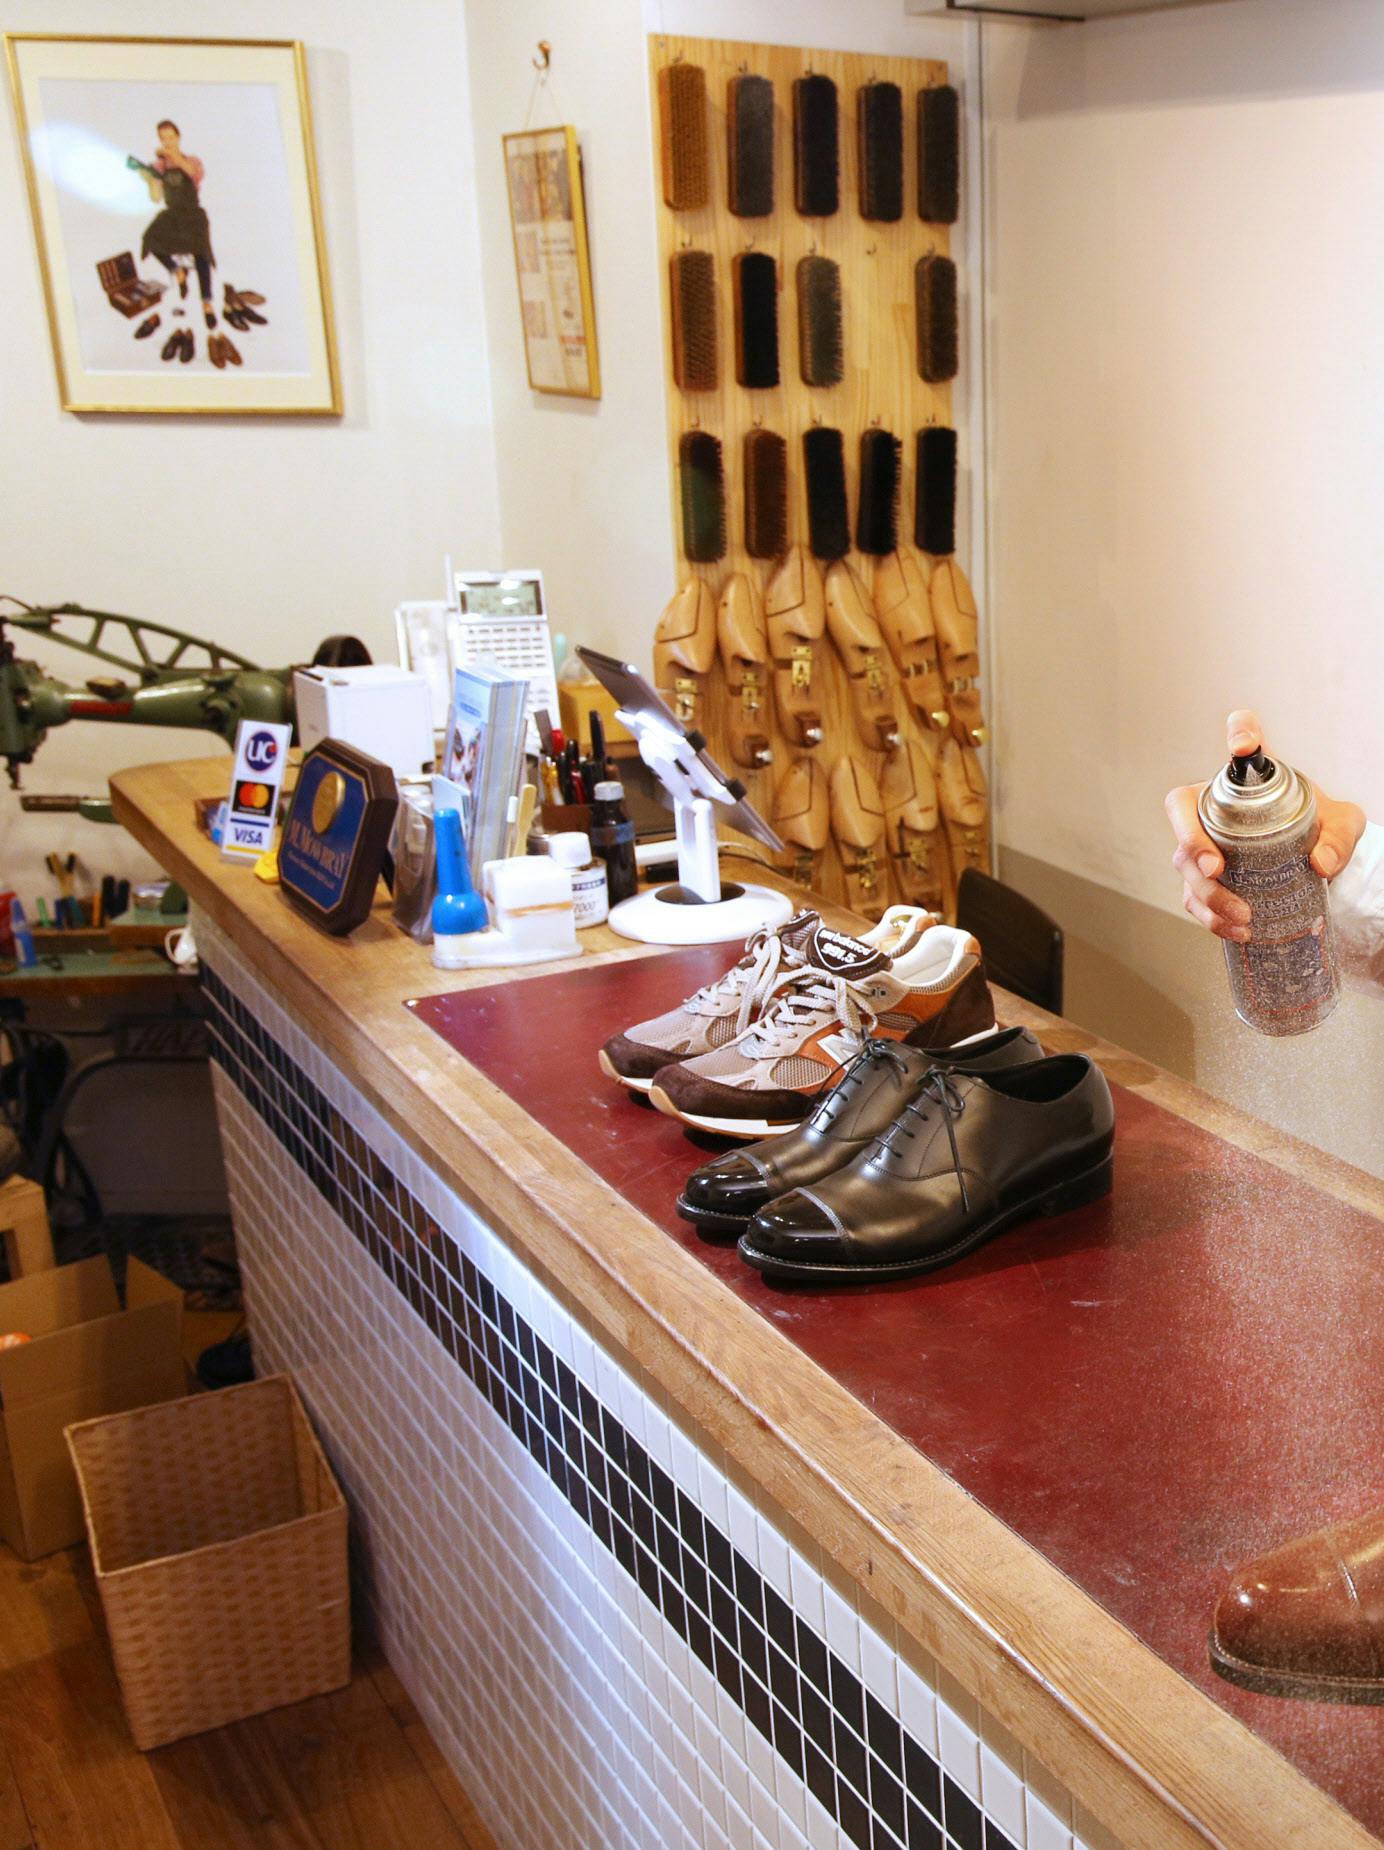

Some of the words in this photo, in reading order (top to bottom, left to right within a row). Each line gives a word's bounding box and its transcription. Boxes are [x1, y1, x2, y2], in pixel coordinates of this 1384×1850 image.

[247, 740, 277, 764] UC
[234, 827, 263, 844] VISA
[821, 942, 858, 963] 991.5
